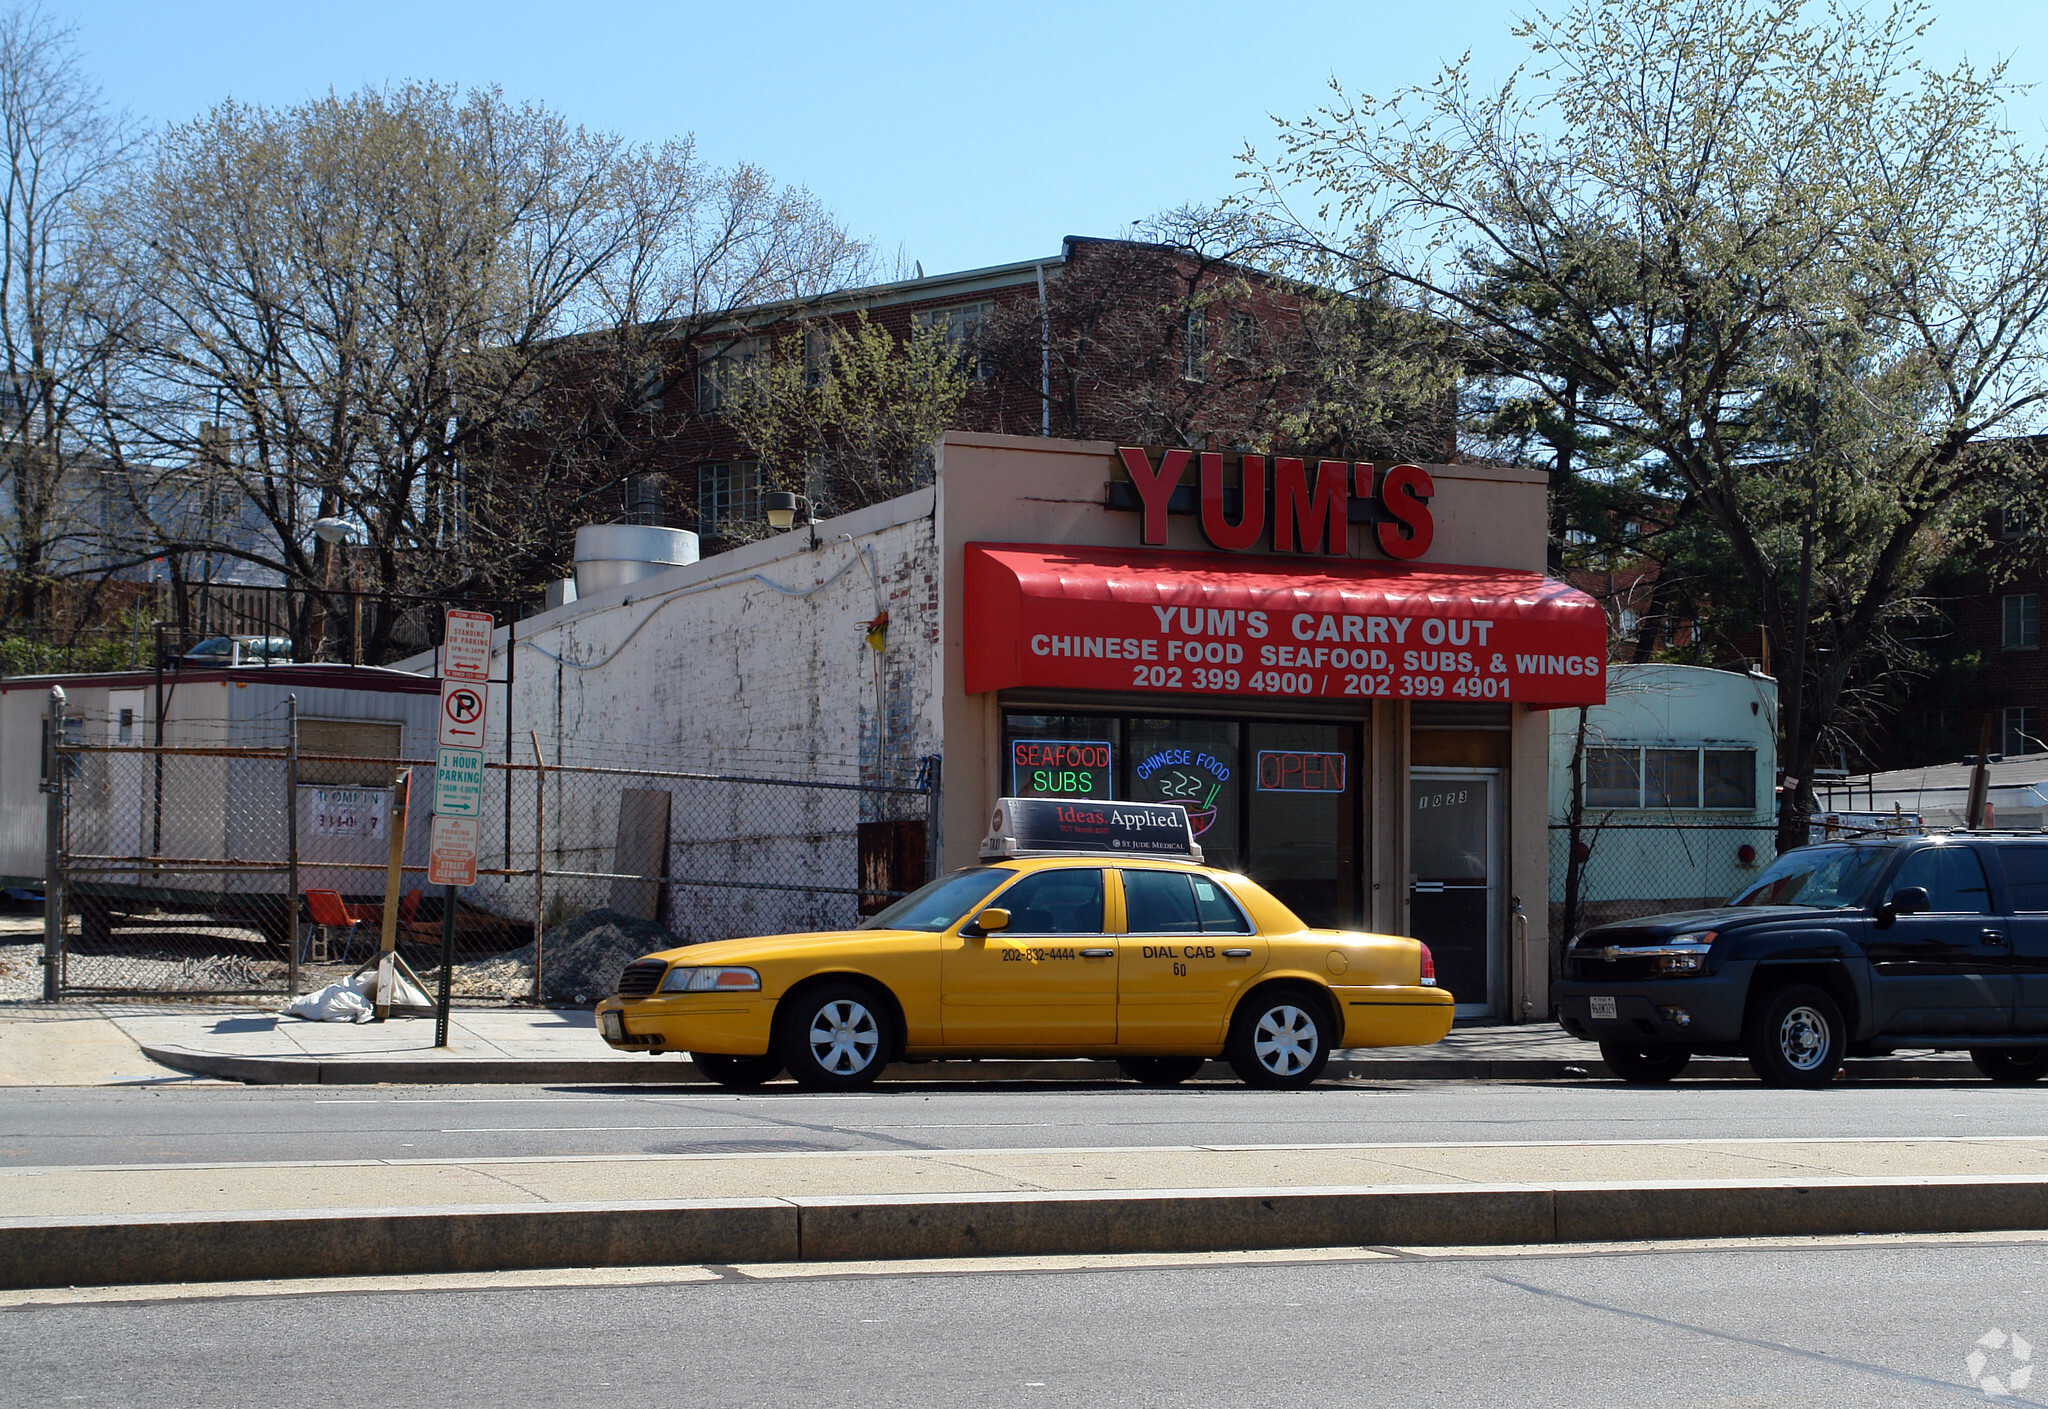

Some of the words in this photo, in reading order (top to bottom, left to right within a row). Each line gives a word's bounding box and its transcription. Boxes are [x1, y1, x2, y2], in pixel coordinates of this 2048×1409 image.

[1118, 446, 1435, 560] YUM'S
[454, 628, 485, 638] STANDING
[1152, 605, 1269, 638] YUM'S
[1291, 613, 1412, 643] CARRY
[1421, 618, 1494, 647] OUT
[449, 635, 458, 644] OR
[460, 636, 488, 647] PARKING
[1031, 634, 1158, 660] CHINESE
[1168, 640, 1243, 664] FOOD
[1260, 645, 1395, 674] SEAFOOD,
[1403, 650, 1480, 677] SUBS,
[1489, 653, 1507, 673] &
[1515, 654, 1599, 676] WINGS
[1133, 665, 1182, 688] 202
[1192, 668, 1240, 690] 399
[1249, 671, 1313, 694] 4900
[1320, 674, 1328, 695] /
[1344, 674, 1390, 695] 202
[1399, 675, 1445, 697] 399
[1452, 677, 1510, 698] 4901
[443, 755, 448, 767] 1
[452, 756, 478, 769] HOUR
[1014, 745, 1110, 768] SEAFOOD
[1136, 749, 1192, 781] CHINESE
[1196, 751, 1231, 783] FOOD
[1259, 754, 1345, 789] OPEN
[438, 769, 480, 784] PARKING
[1032, 771, 1093, 793] SUBS
[1421, 791, 1467, 808] 1023
[1056, 806, 1109, 825] Ideas.
[1110, 809, 1183, 830] Applied.
[1132, 840, 1150, 849] JUDE
[1152, 841, 1185, 850] MEDICAL
[436, 869, 469, 879] CLEANING
[441, 861, 466, 870] STREET
[1002, 948, 1075, 961] 202-832-4444
[1143, 946, 1178, 959] DIAL
[1183, 946, 1216, 959] CAB
[1173, 962, 1186, 977] 60
